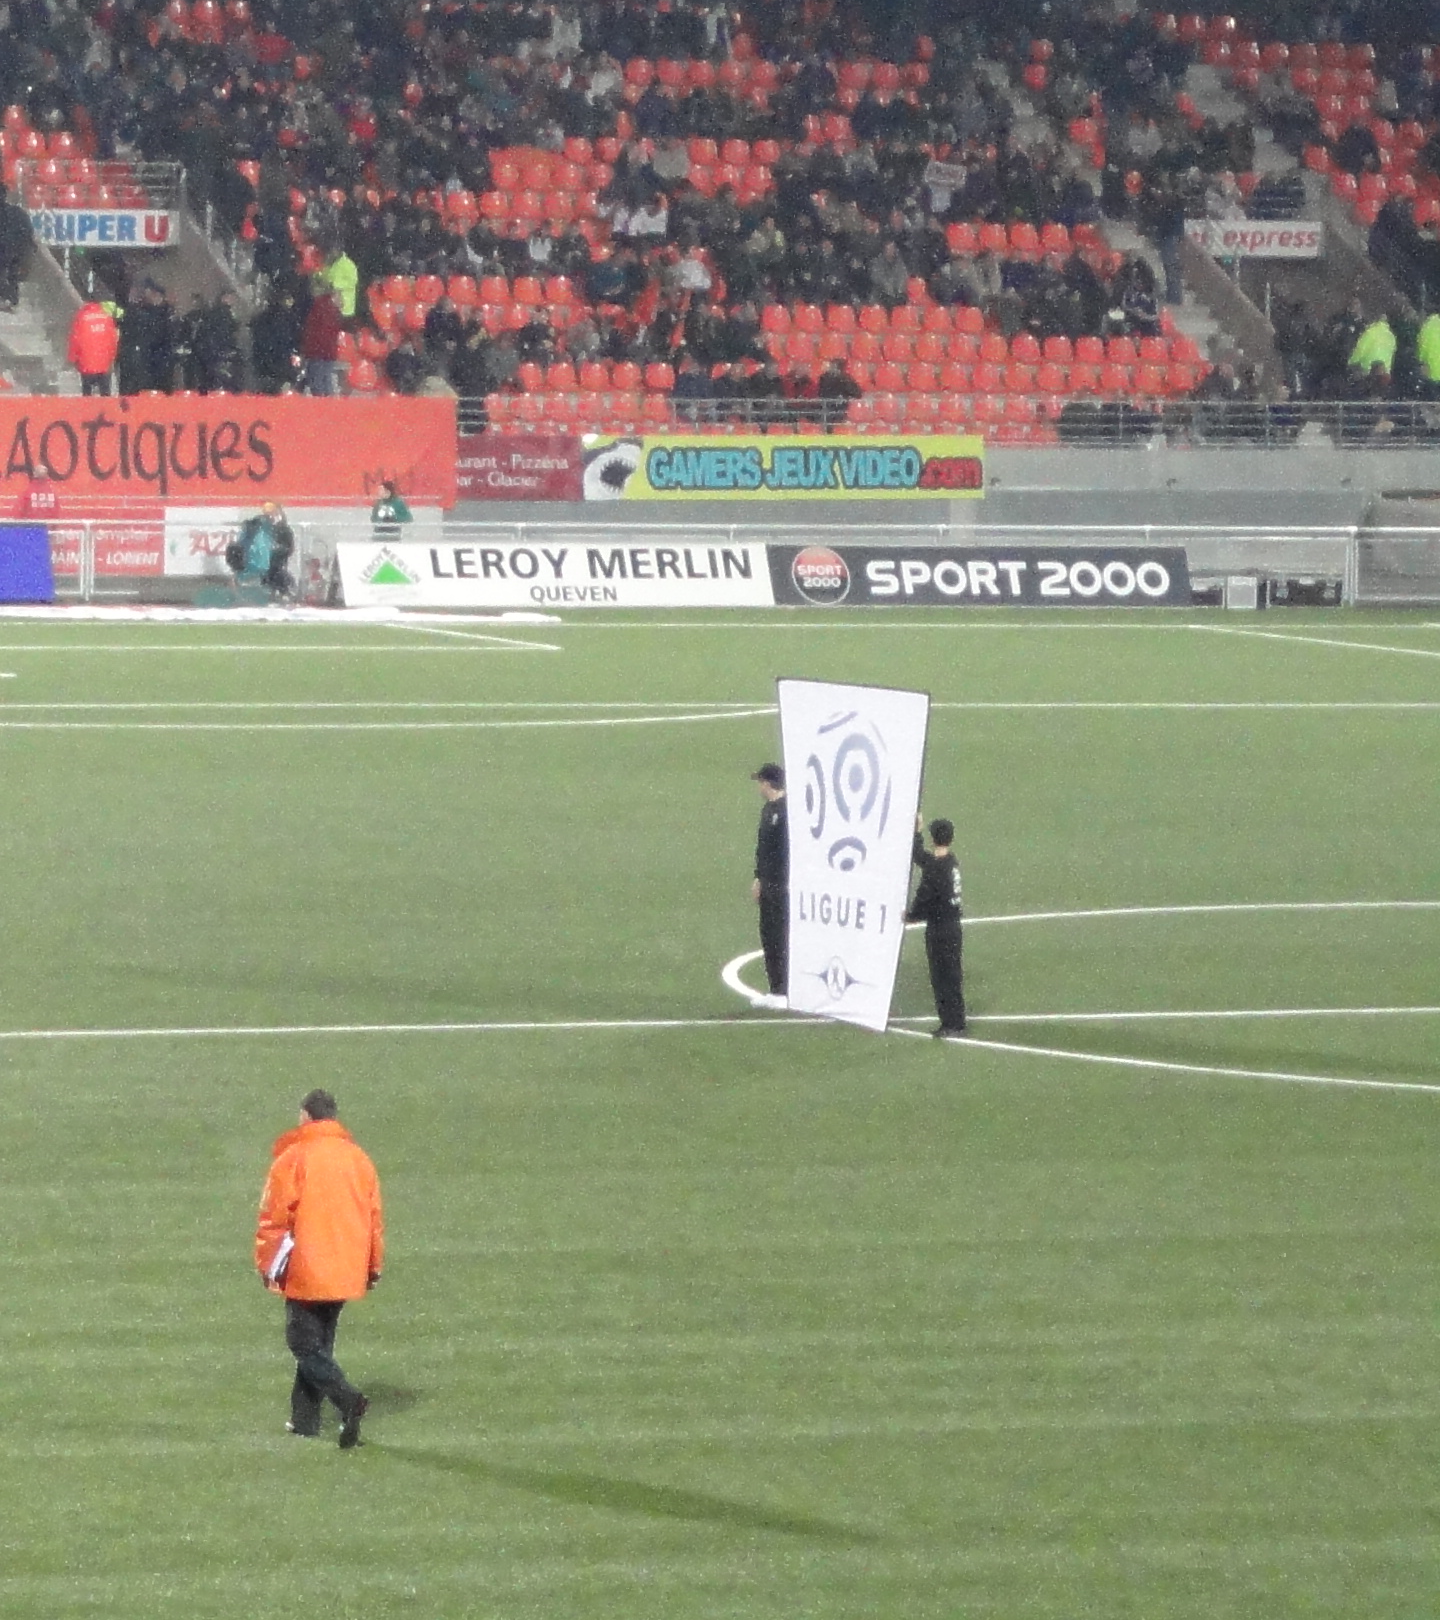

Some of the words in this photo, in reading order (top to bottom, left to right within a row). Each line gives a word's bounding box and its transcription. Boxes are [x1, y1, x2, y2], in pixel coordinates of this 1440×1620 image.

[31, 214, 138, 242] SUPER
[144, 215, 170, 244] U
[1223, 230, 1317, 253] express
[649, 446, 763, 490] GAMERS
[430, 547, 568, 580] LEROY
[587, 548, 753, 580] MERLIN
[796, 563, 843, 577] SPORT
[865, 560, 1027, 596] SPORT
[1036, 561, 1171, 597] 2000
[530, 585, 618, 603] QUEVEN
[802, 576, 842, 589] 2000
[799, 891, 866, 930] LIGUE
[877, 903, 887, 934] 1
